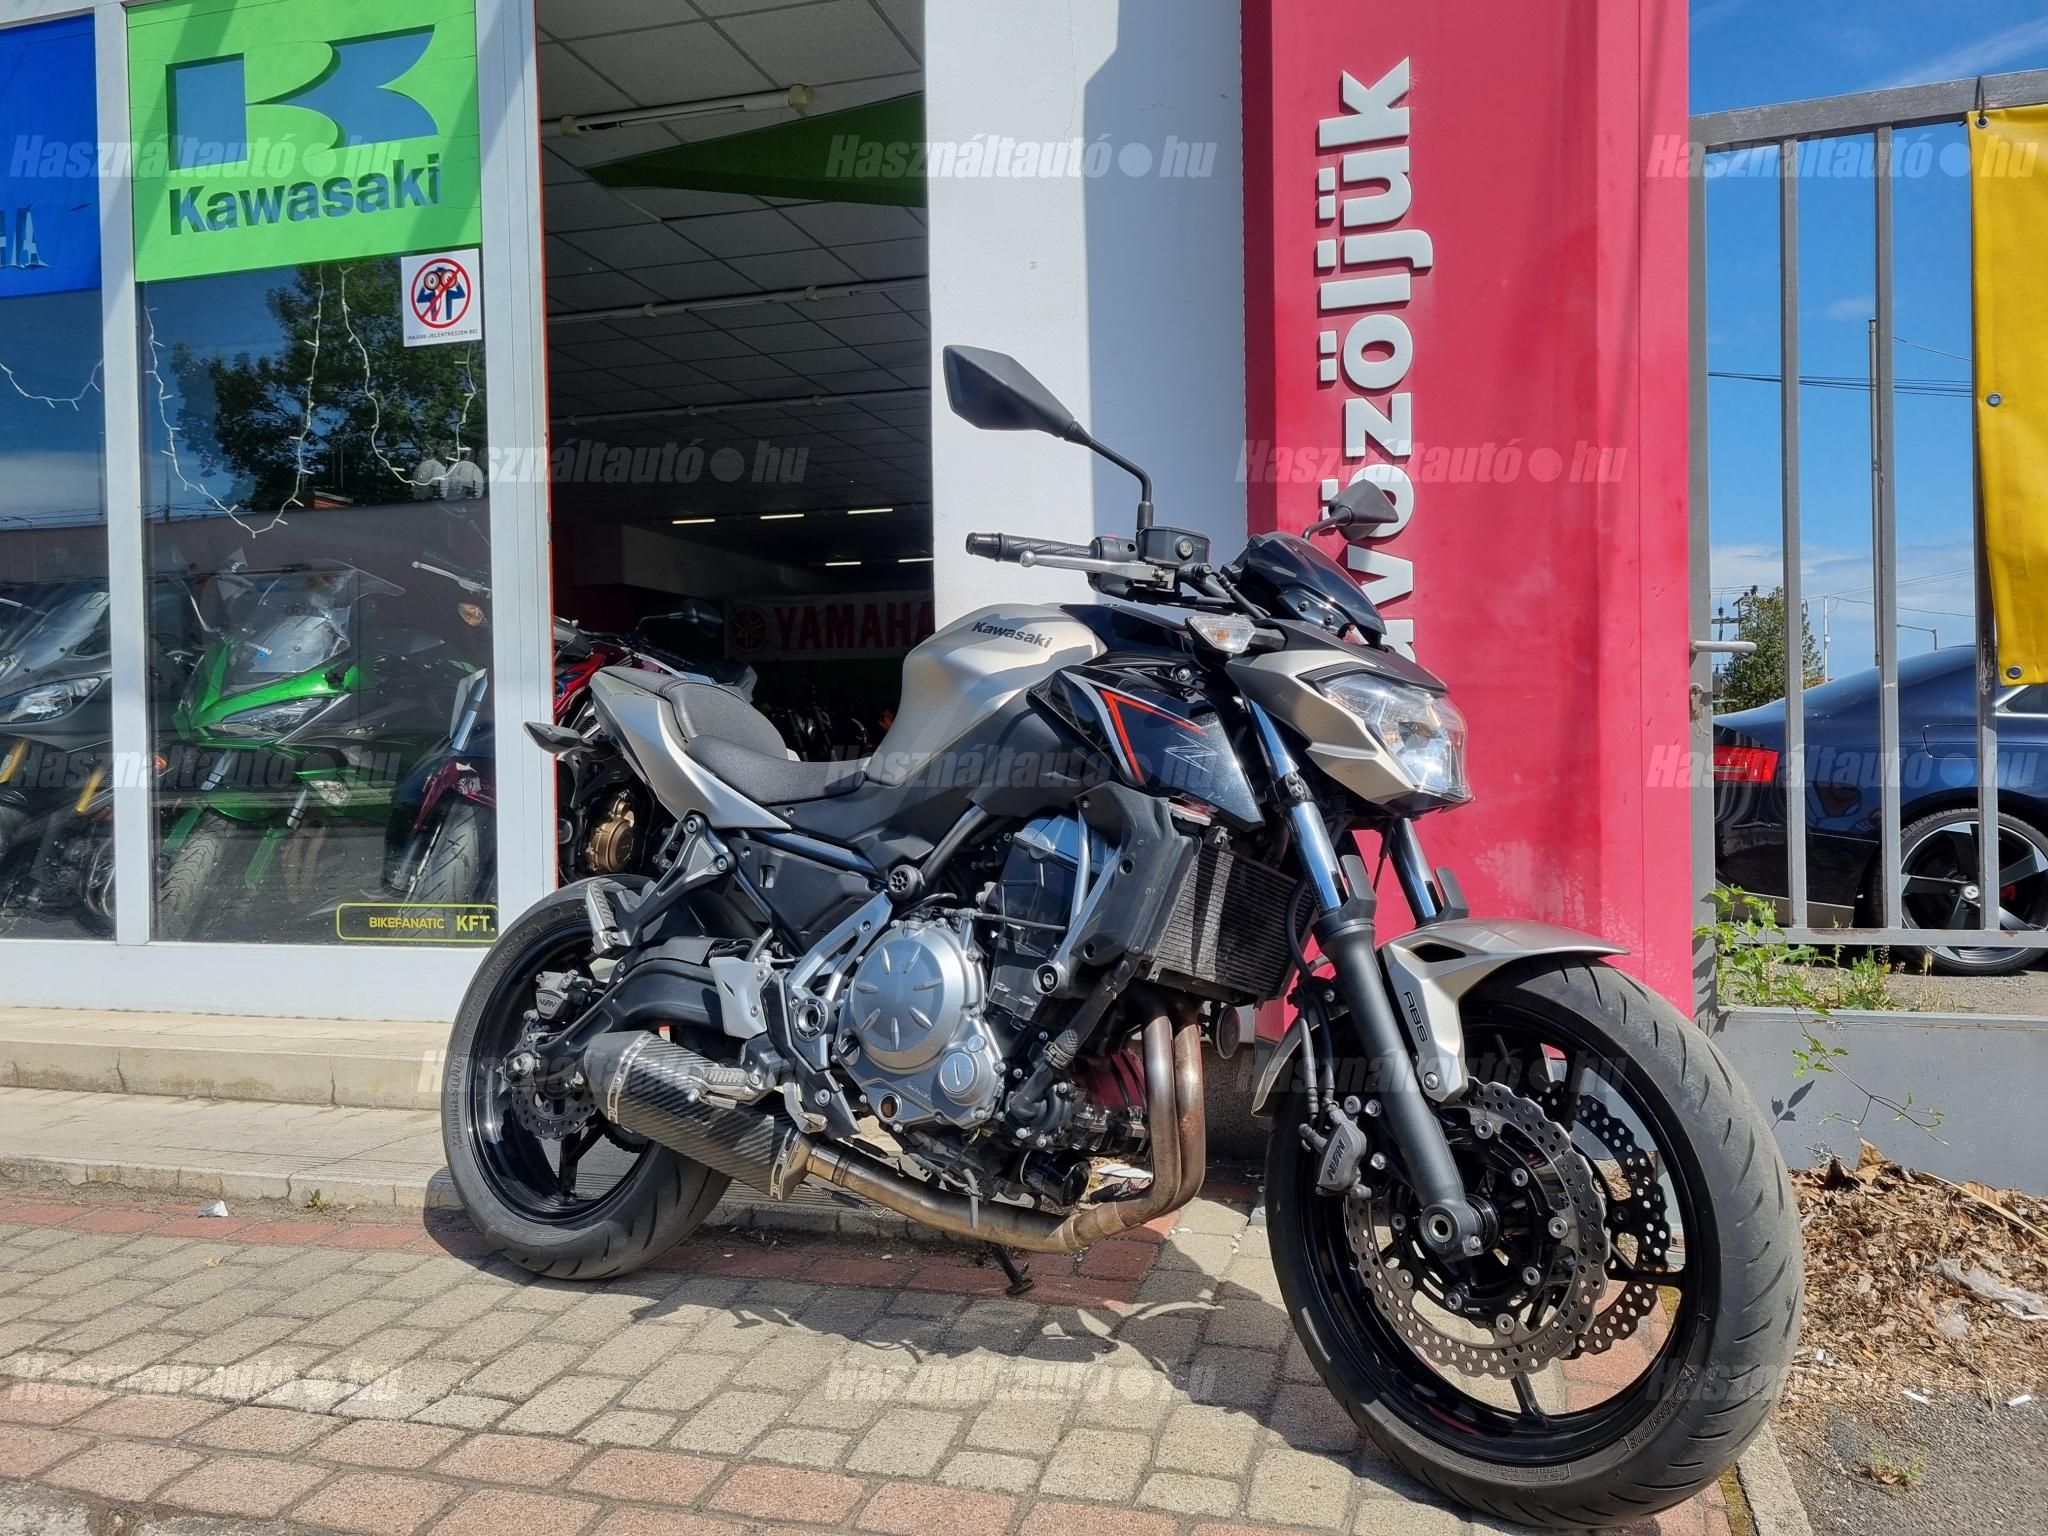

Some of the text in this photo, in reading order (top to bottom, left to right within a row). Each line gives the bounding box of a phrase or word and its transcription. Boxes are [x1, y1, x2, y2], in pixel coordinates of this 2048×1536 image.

[169, 153, 440, 235] Kawasaki
[774, 601, 935, 650] YAMAHA
[972, 621, 1053, 648] Kawasaki
[369, 914, 496, 932] BIKEFANATIC KFT.
[1404, 991, 1428, 1042] ABS
